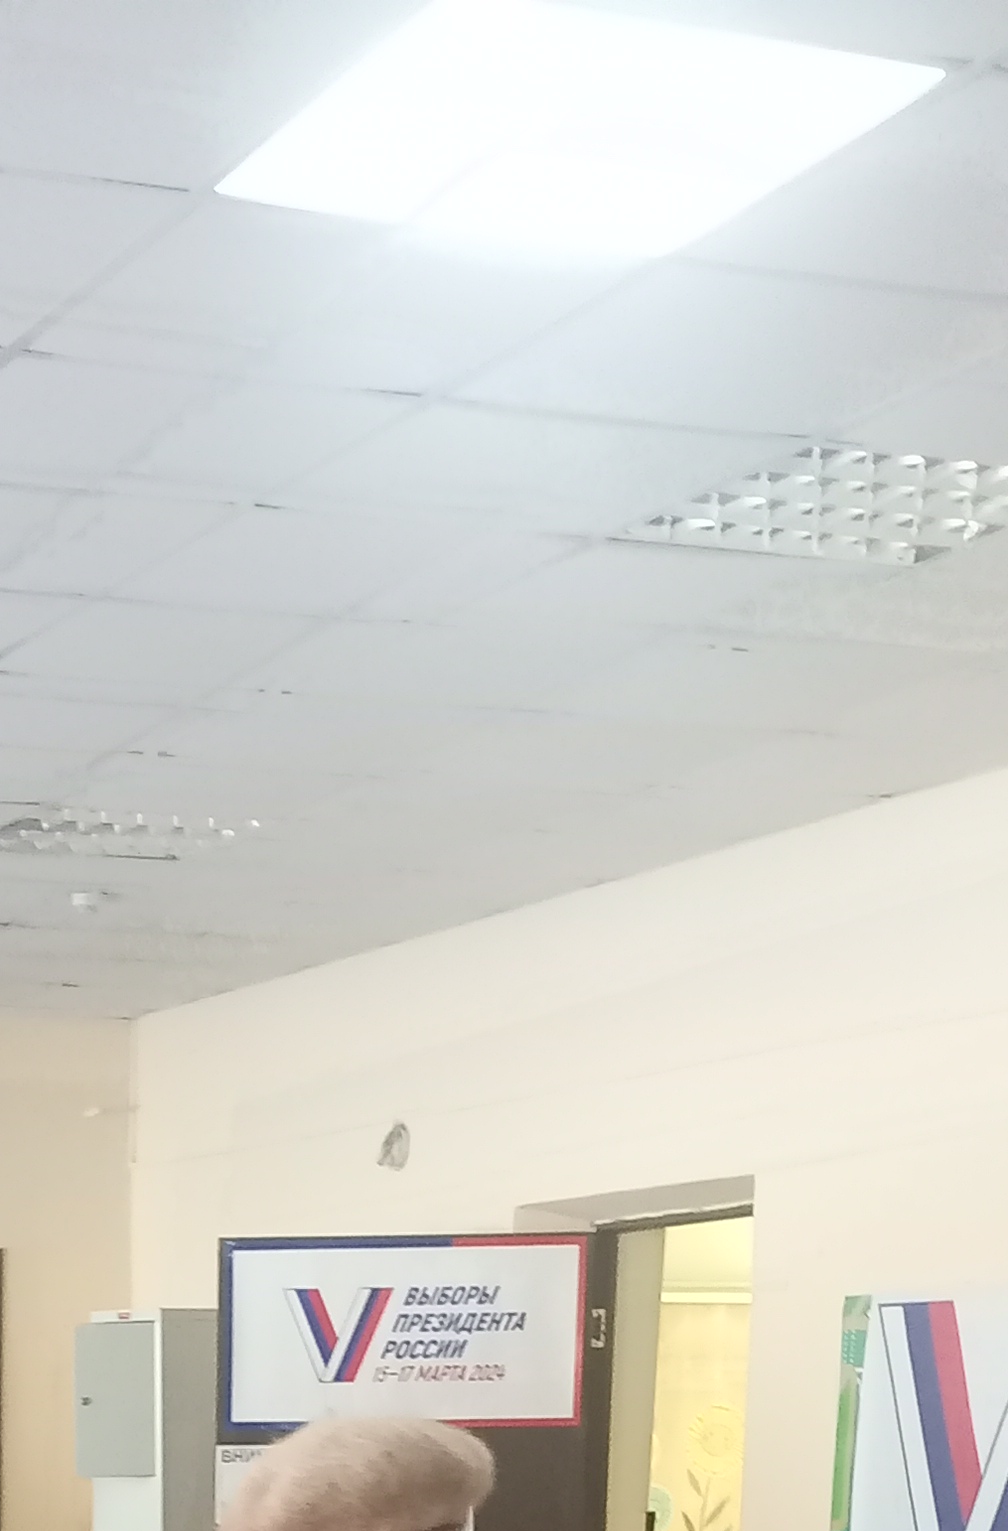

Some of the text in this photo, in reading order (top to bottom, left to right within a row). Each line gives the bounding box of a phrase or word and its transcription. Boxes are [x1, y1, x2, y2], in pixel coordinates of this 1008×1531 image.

[403, 1285, 501, 1306] ВЫБОРЫ
[391, 1311, 527, 1335] ПРЕЗИДЕНТА
[380, 1339, 469, 1360] РОССИИ
[414, 1364, 468, 1382] МАРТА
[468, 1363, 507, 1382] 2024
